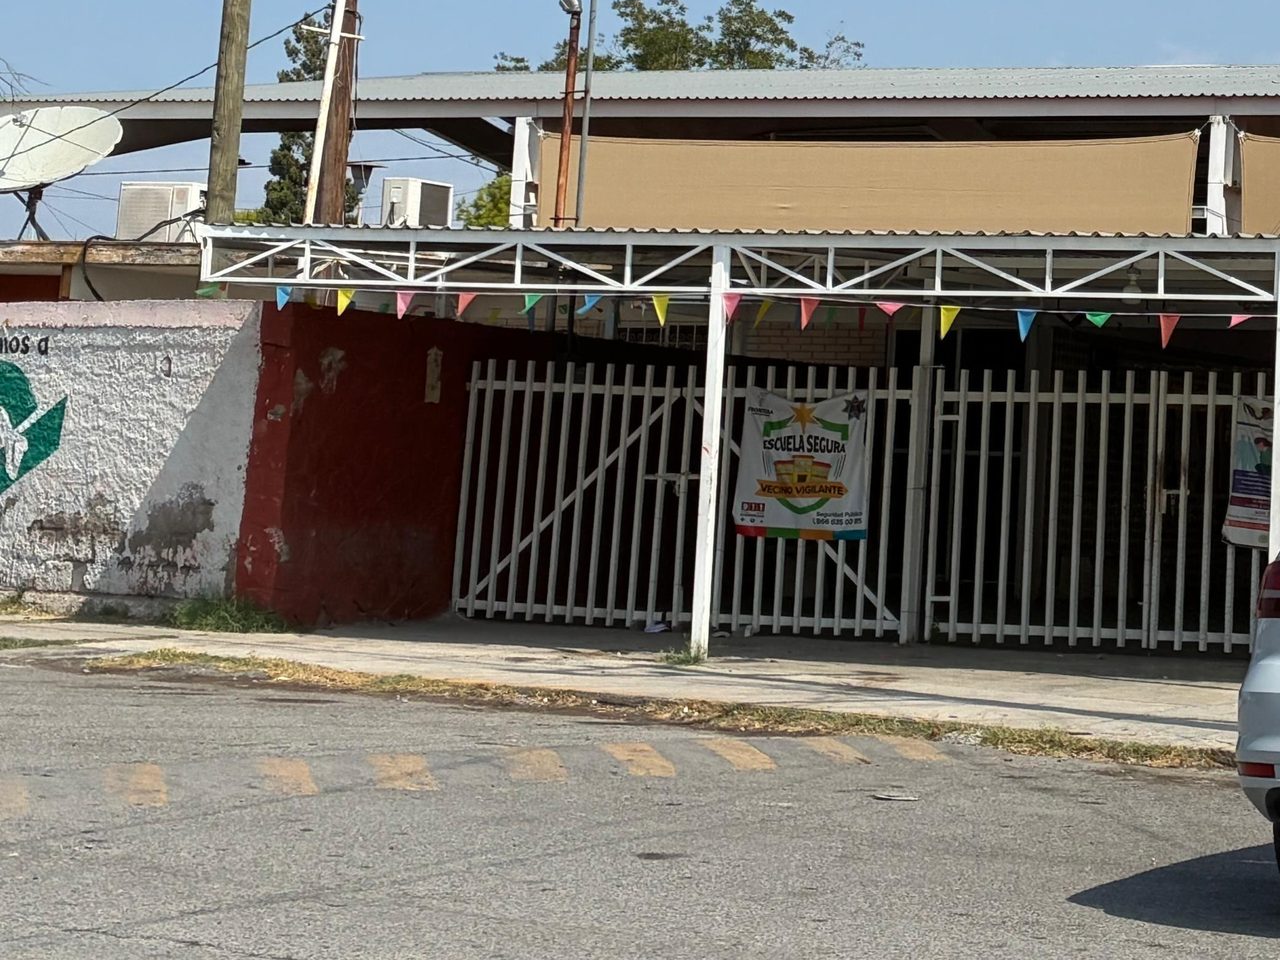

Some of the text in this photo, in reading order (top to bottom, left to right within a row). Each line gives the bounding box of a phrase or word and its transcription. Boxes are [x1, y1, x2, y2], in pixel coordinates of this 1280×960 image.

[38, 336, 49, 356] a
[763, 435, 846, 453] ESCUELA SEGURA
[760, 483, 845, 496] VECINO VIGILANTE
